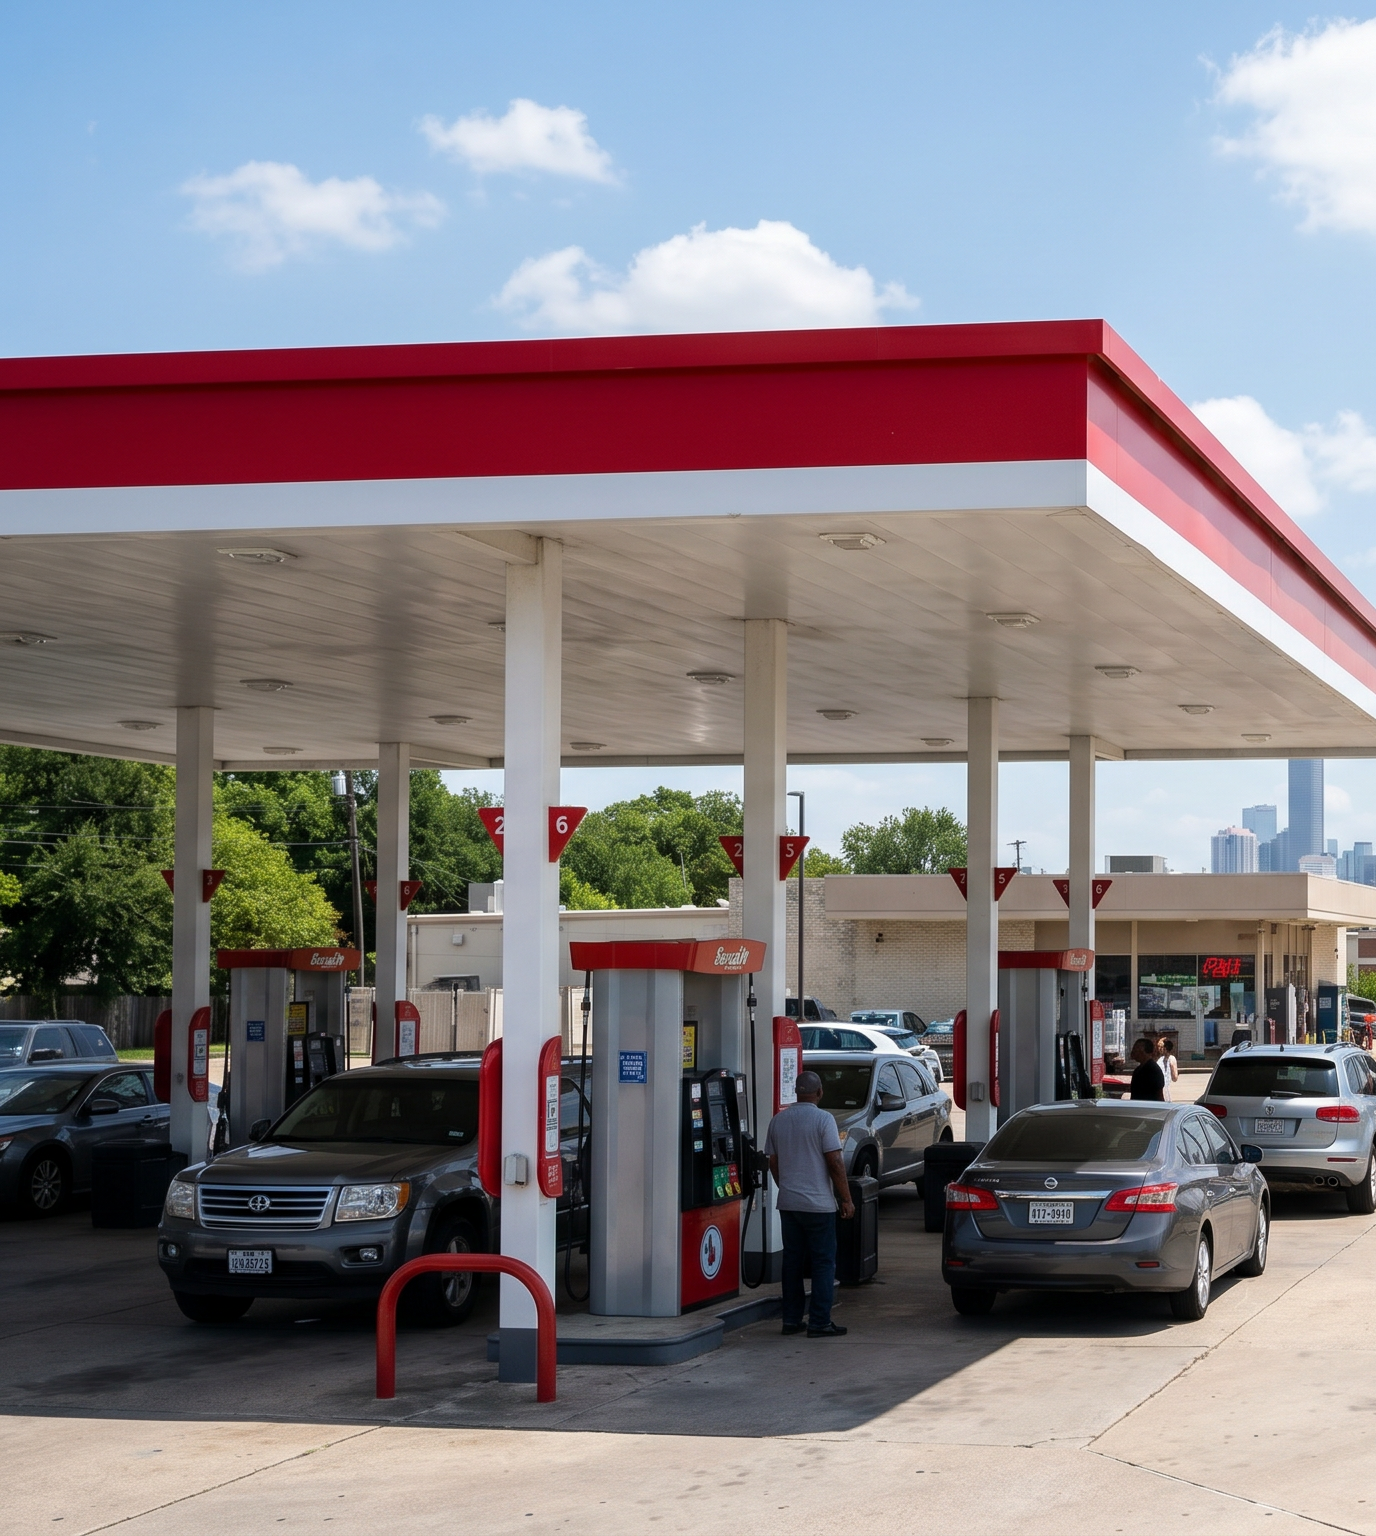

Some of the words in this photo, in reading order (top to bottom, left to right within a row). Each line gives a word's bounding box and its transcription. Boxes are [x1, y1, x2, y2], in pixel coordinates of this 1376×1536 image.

[556, 815, 568, 834] 6
[734, 843, 743, 857] 2
[785, 843, 795, 858] 5
[998, 873, 1006, 884] 5
[404, 886, 410, 895] 6
[1095, 884, 1103, 894] 6
